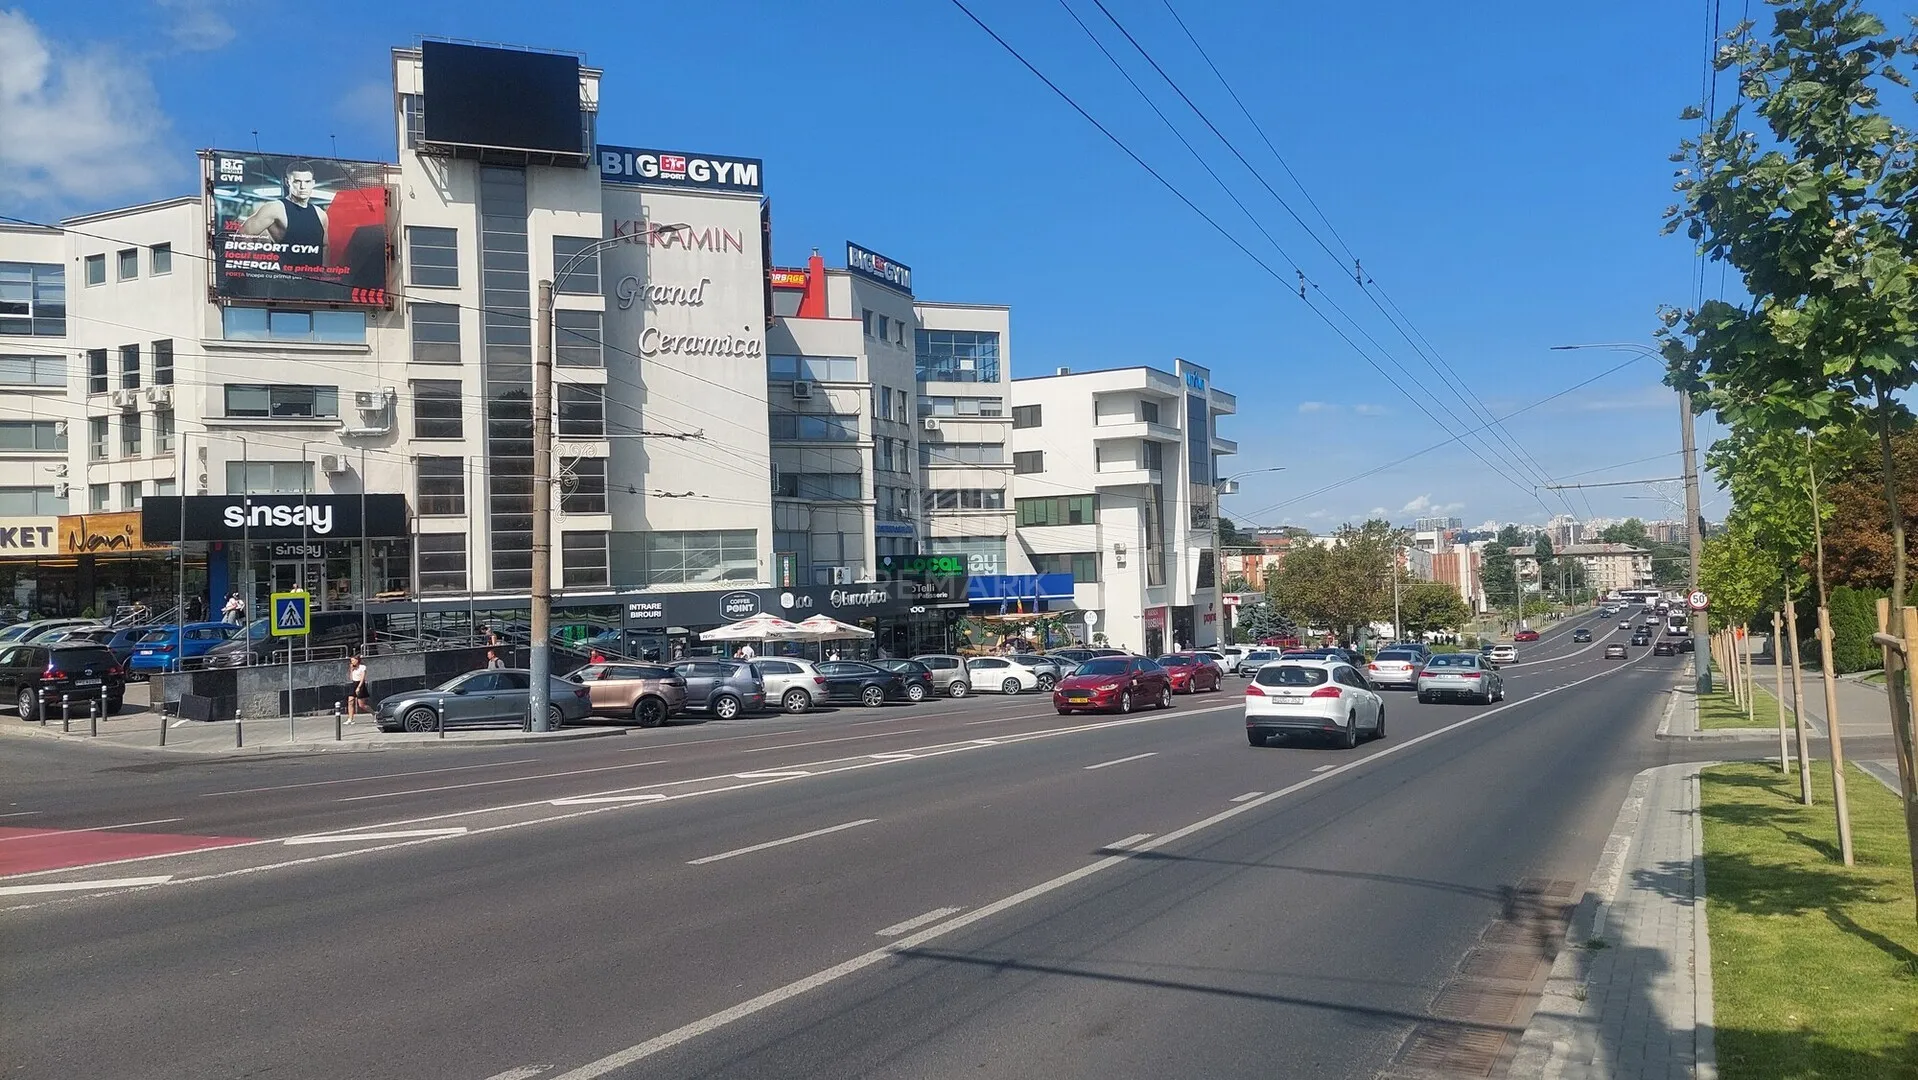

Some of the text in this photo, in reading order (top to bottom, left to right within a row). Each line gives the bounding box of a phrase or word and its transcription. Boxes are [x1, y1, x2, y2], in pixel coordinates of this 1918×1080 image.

[602, 151, 659, 177] BIG
[688, 159, 758, 186] GYM
[220, 174, 243, 182] GYM
[661, 172, 686, 180] SPORT
[614, 219, 743, 254] KERAMIN
[224, 240, 319, 254] BIGSPORT GYM
[225, 251, 280, 261] locul unde
[225, 260, 280, 271] ENERGIA
[294, 265, 324, 273] prinde
[849, 246, 875, 273] BIG
[884, 262, 910, 289] GYM
[616, 275, 711, 310] Grand
[638, 325, 761, 358] Ceramica
[223, 499, 333, 534] sinsay
[275, 543, 321, 558] sinsay
[967, 554, 998, 576] ay
[629, 602, 662, 611] INTRARE
[1693, 595, 1704, 604] 50
[630, 610, 662, 619] BIROURI
[726, 603, 755, 613] POINT
